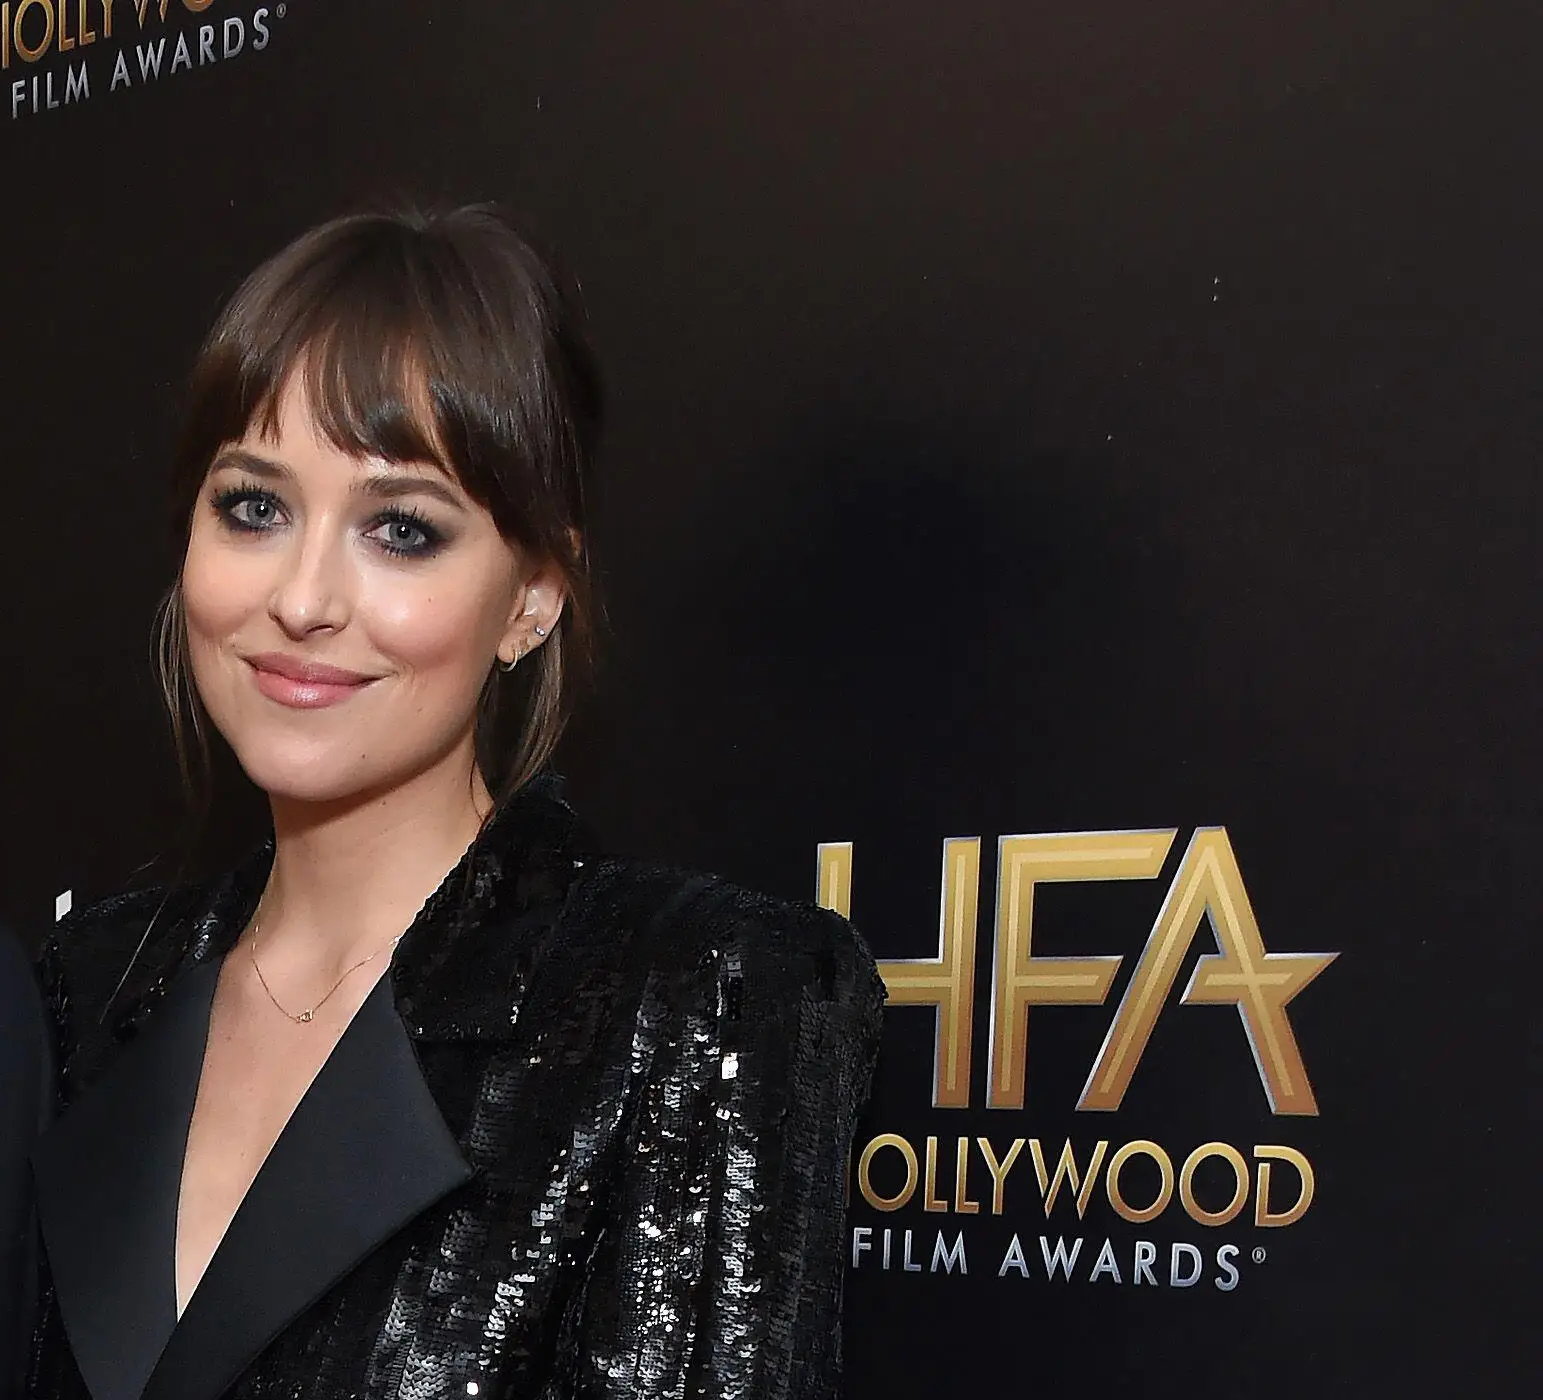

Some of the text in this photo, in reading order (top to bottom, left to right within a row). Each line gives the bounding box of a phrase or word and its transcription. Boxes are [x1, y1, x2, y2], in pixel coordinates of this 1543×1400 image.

[11, 60, 91, 119] FILM
[857, 1133, 1315, 1228] OLLYWOOD
[852, 1226, 969, 1275] FILM
